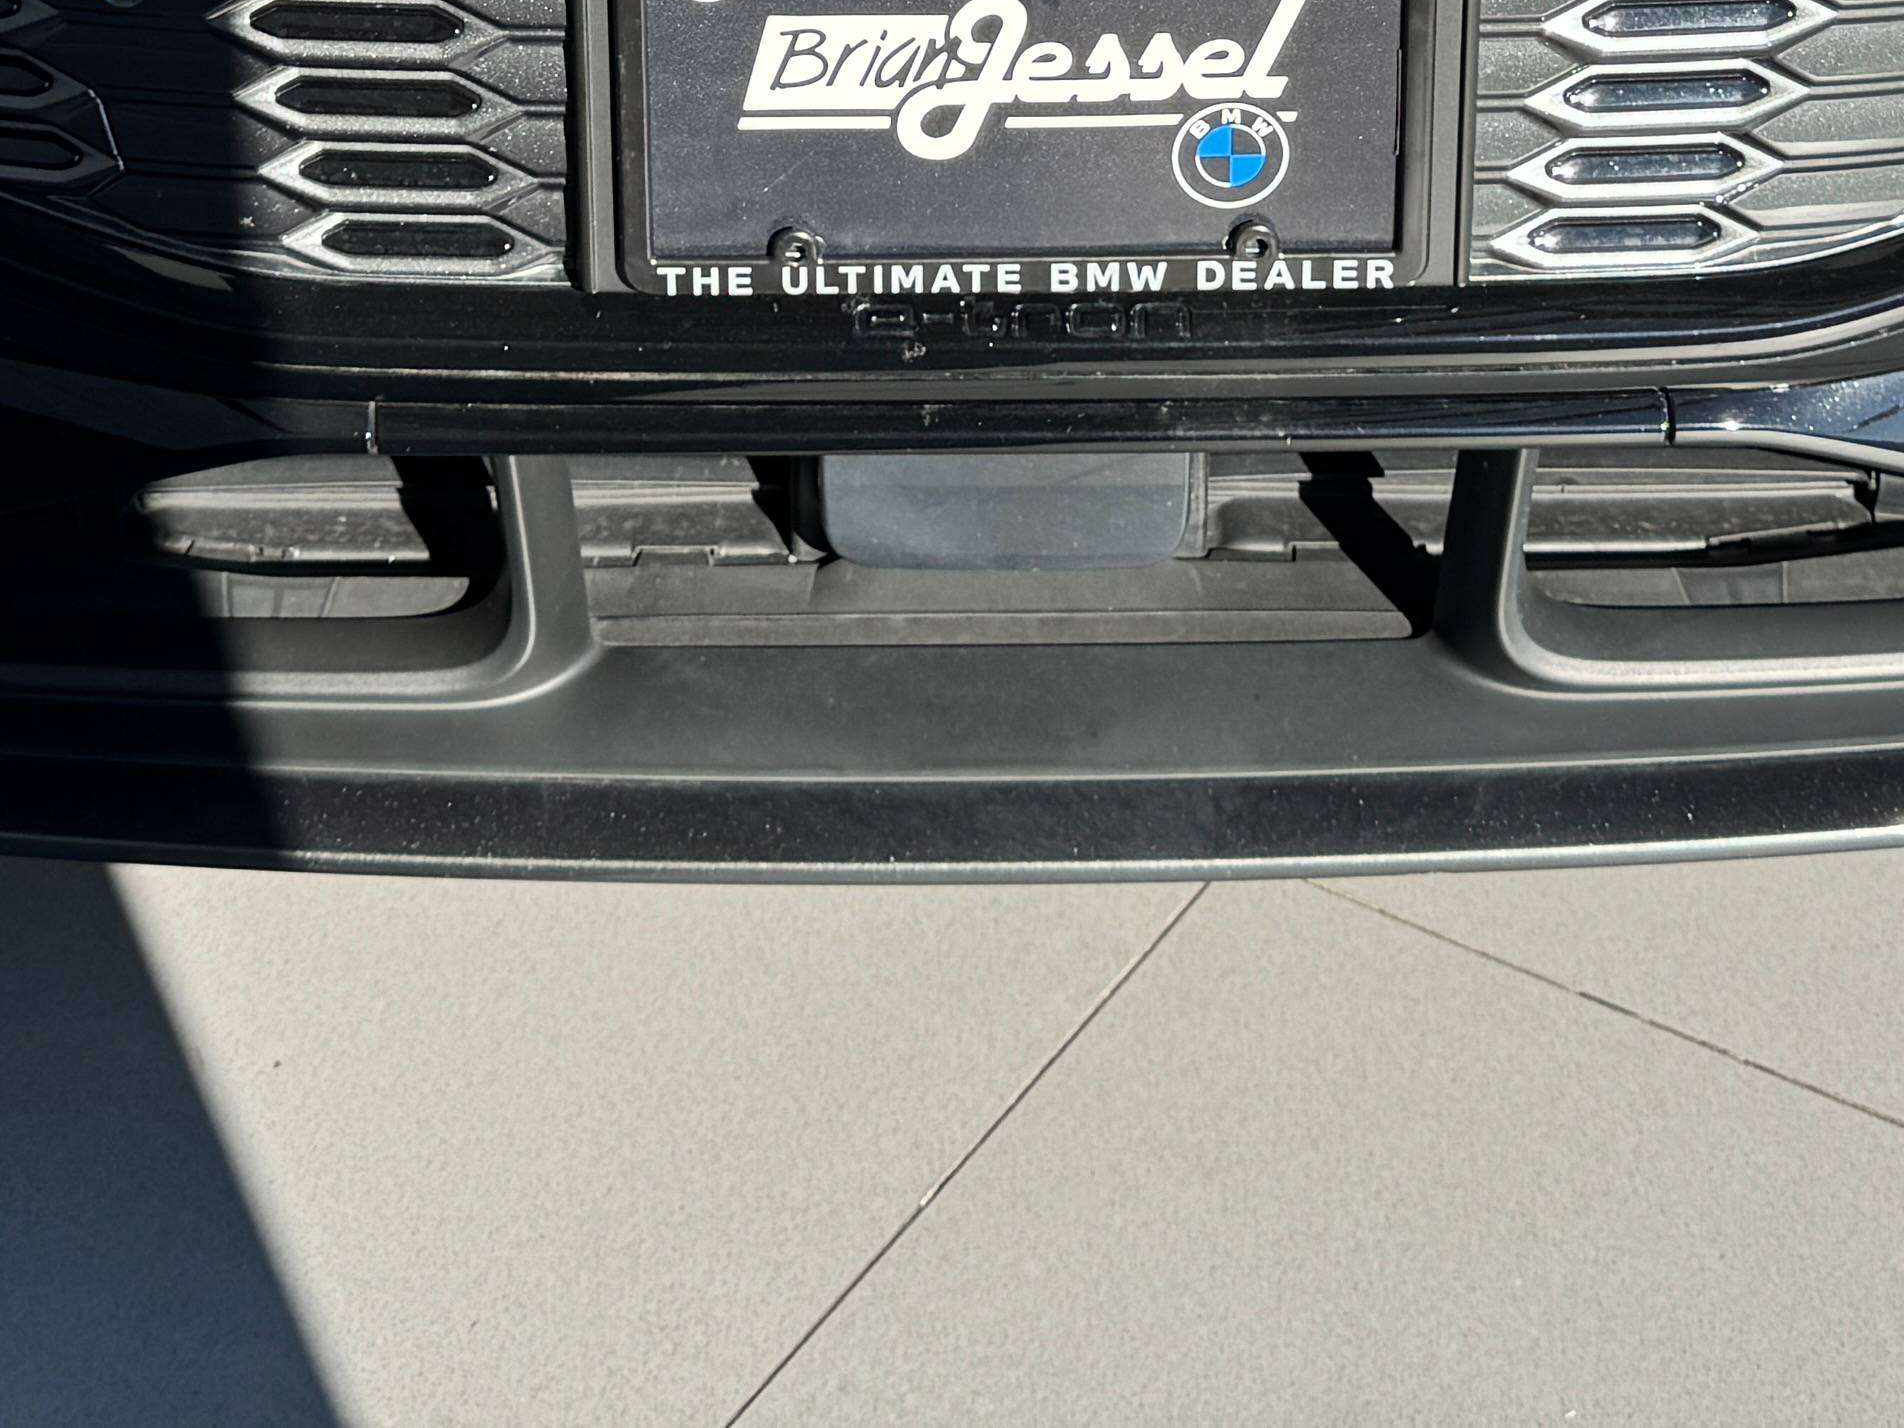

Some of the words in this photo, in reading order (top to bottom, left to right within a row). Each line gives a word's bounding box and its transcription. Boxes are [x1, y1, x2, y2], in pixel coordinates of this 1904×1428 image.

[770, 28, 968, 91] Brian
[655, 266, 754, 297] THE
[781, 263, 1023, 296] ULTIMATE
[1049, 260, 1168, 294] BMW
[1196, 258, 1395, 292] DEALER
